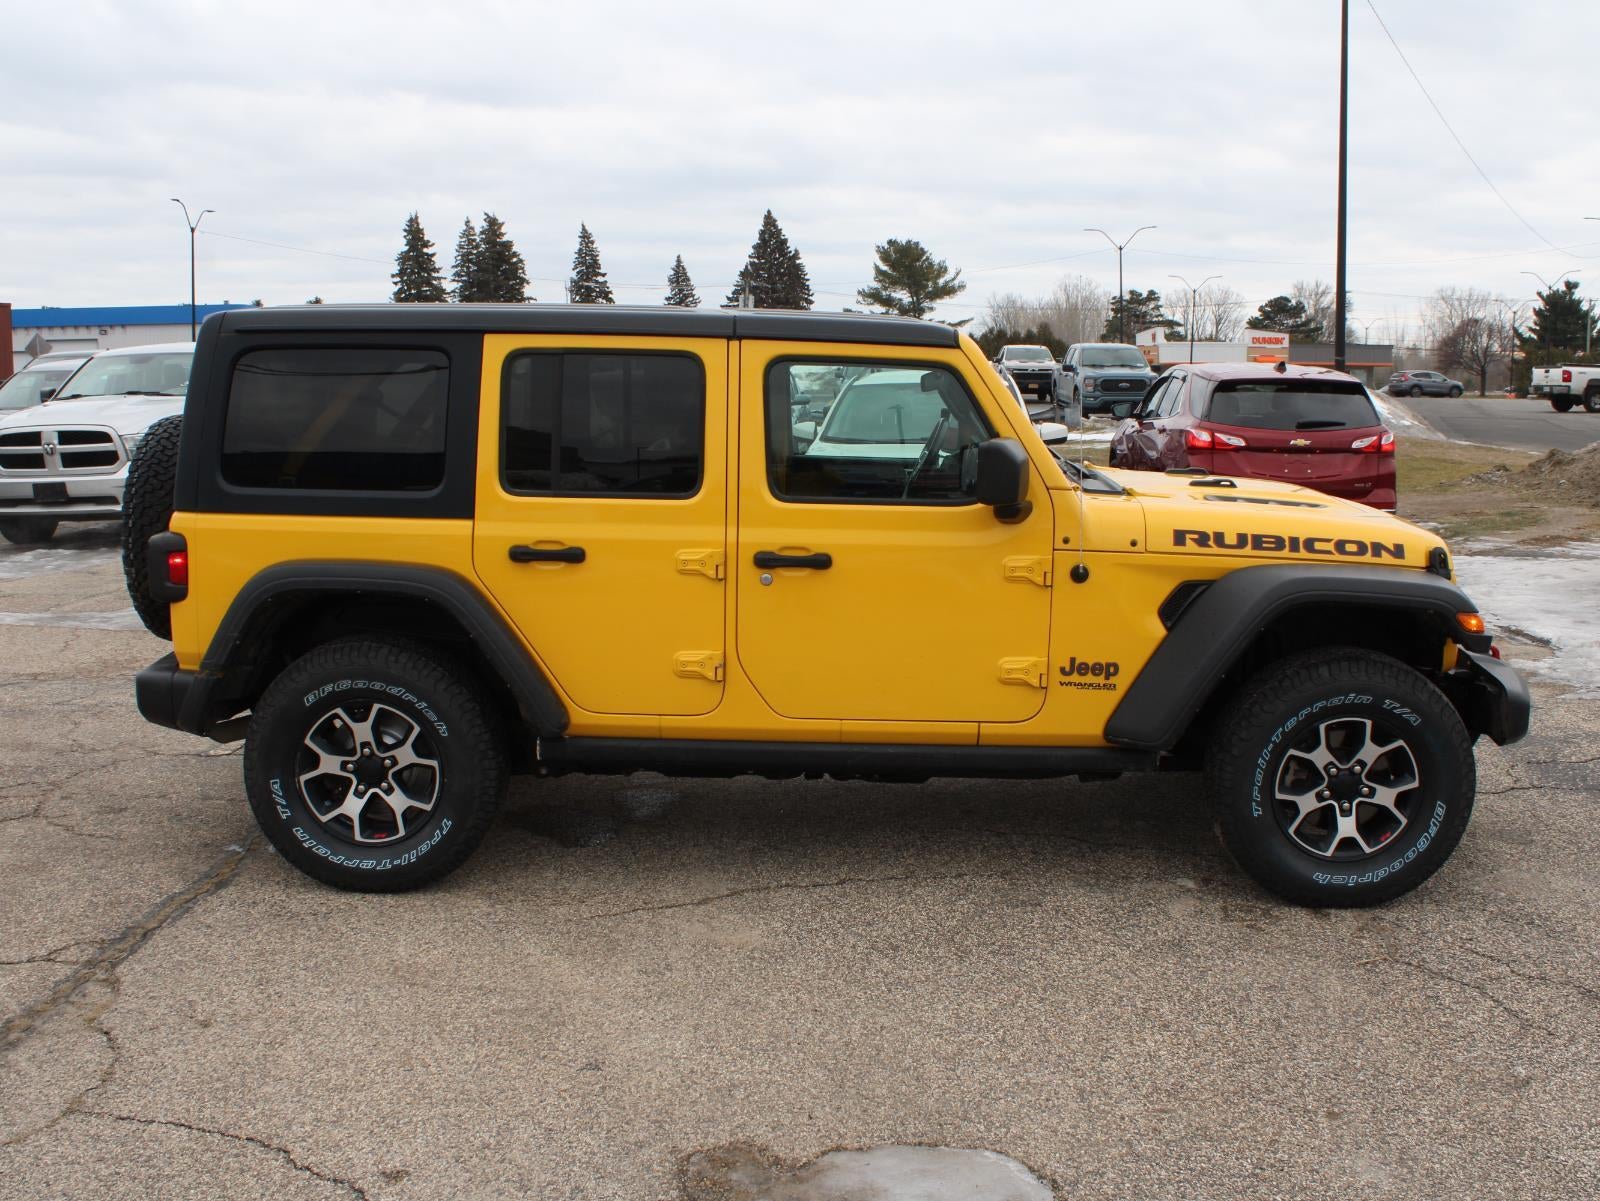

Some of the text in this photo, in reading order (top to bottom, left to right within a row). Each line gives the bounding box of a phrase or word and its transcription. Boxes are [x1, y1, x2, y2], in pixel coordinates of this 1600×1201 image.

[1252, 336, 1286, 345] DUNKIN'
[1172, 528, 1405, 560] RUBICON
[1059, 656, 1120, 681] Jeep
[1059, 681, 1117, 689] WRANGLER
[304, 680, 448, 737] BFGoodrich
[1251, 693, 1422, 817] Trail-Terrain T/A
[269, 779, 452, 870] Trail-Terrain T/A
[1312, 801, 1447, 886] BFGoodrich
